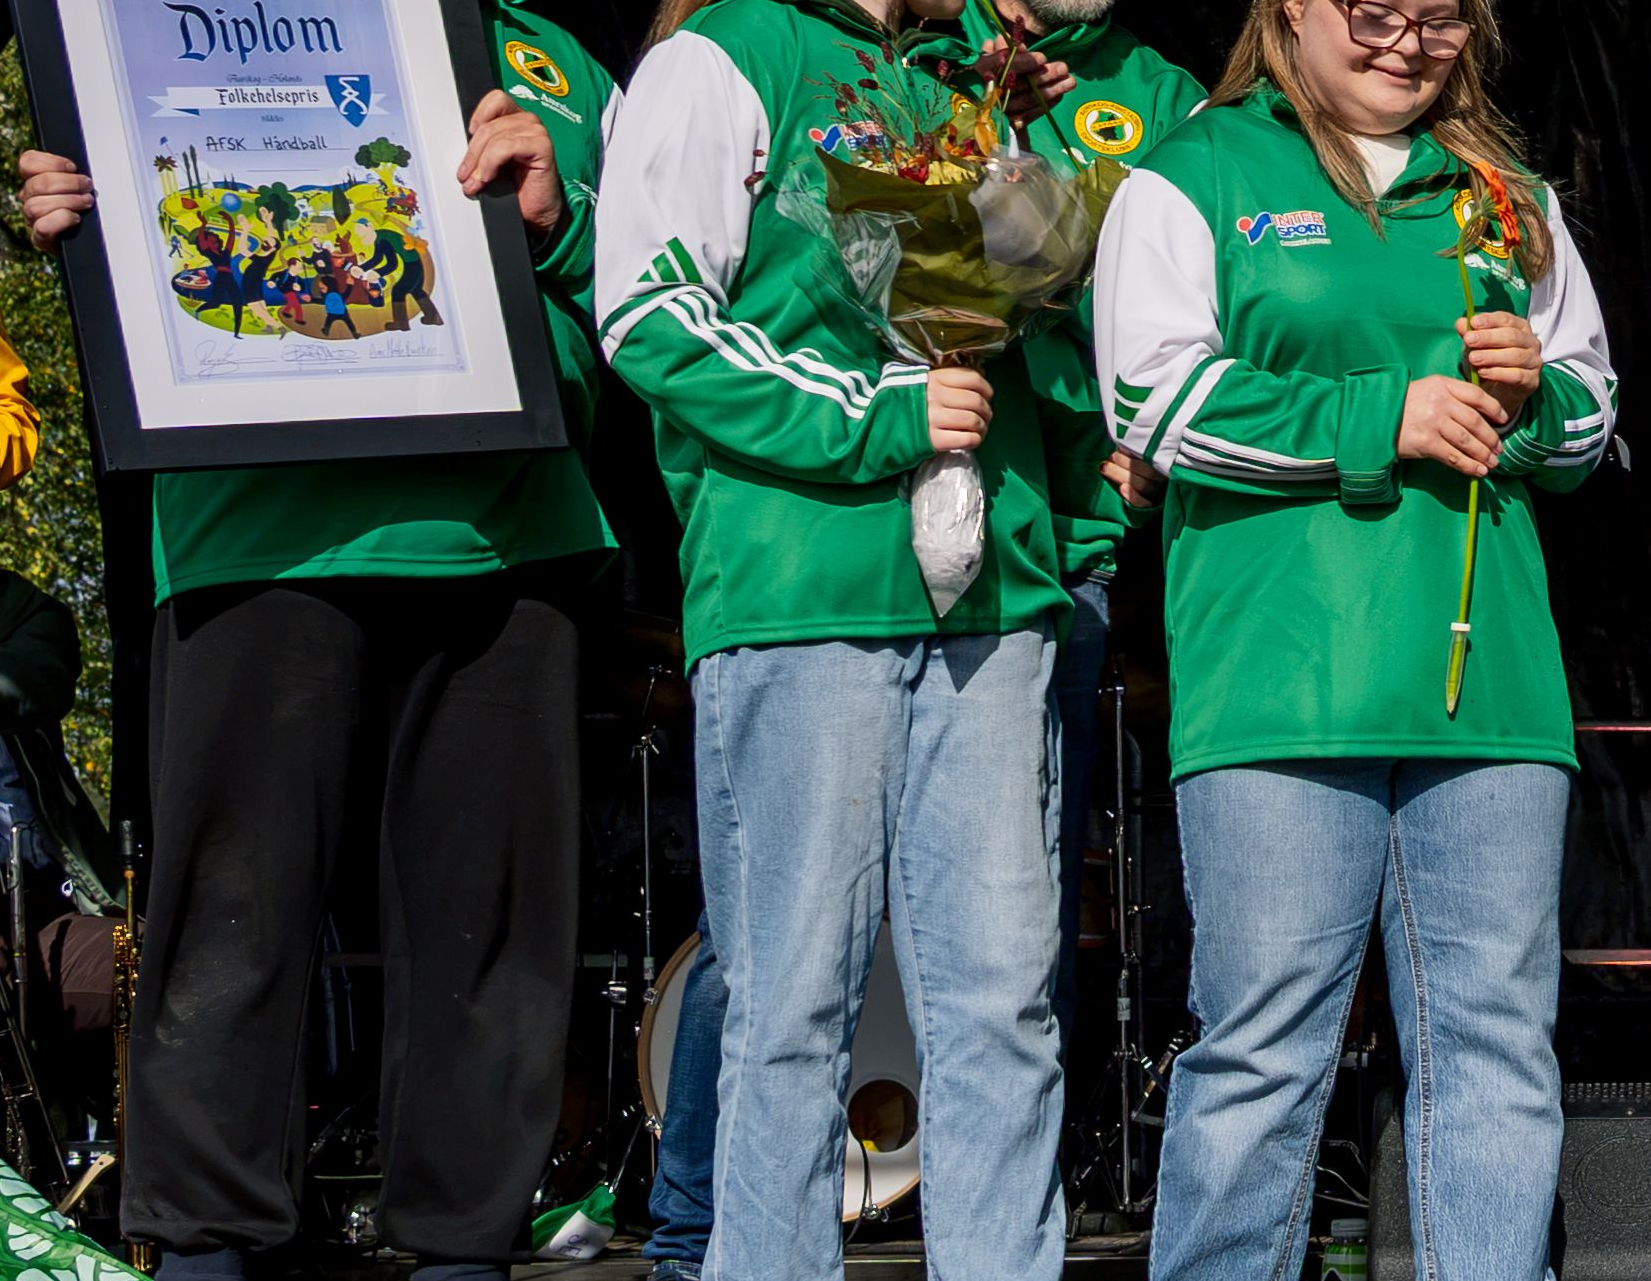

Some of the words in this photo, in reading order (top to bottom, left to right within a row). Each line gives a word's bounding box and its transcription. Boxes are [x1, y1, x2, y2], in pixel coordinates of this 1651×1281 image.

[162, 1, 344, 65] Diplom
[215, 87, 319, 106] Folkehelsepris
[206, 136, 247, 151] AFSK
[262, 135, 328, 151] Håndball
[1277, 223, 1327, 237] SPORT
